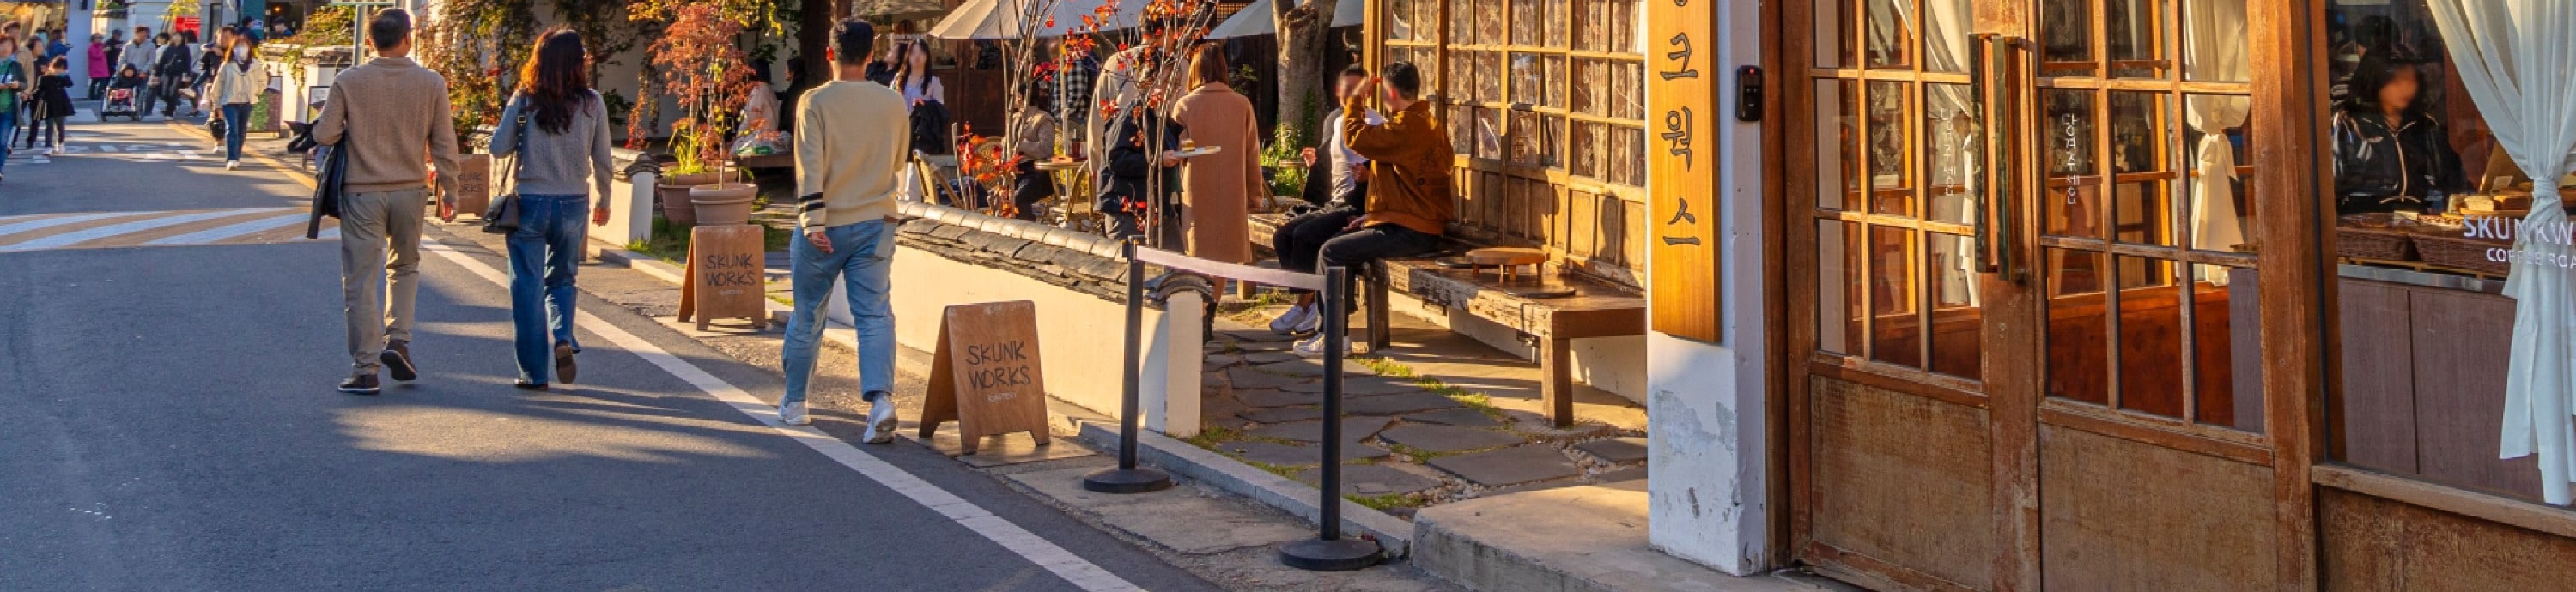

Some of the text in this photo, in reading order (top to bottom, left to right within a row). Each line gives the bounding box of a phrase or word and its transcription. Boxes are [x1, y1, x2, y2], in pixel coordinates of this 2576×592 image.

[1660, 0, 1701, 245] 크웍스
[2061, 113, 2080, 205] 당겨주세요
[706, 252, 753, 270] SKUNK
[2486, 247, 2543, 266] COFFEE
[705, 270, 756, 287] WORKS
[966, 340, 1026, 365] SKUNK
[968, 365, 1031, 389] WORKS
